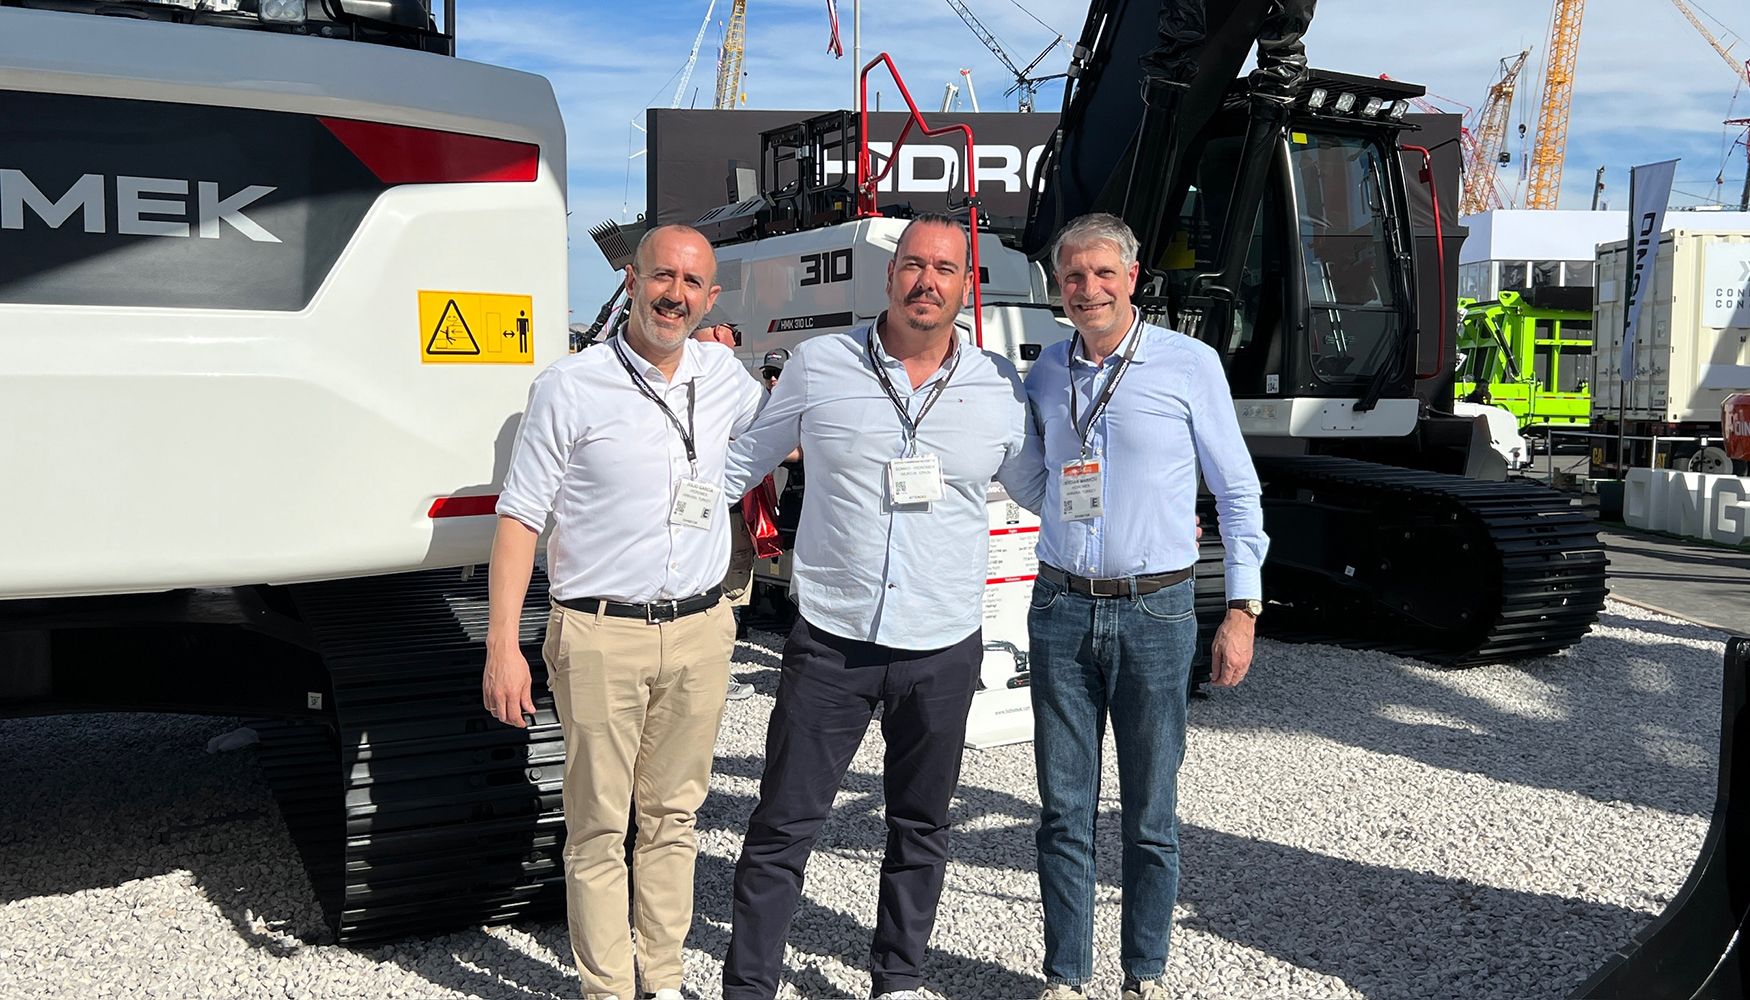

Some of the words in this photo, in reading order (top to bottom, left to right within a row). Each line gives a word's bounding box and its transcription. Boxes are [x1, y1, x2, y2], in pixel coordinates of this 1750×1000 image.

[0, 168, 283, 244] MEK
[800, 247, 853, 287] 310
[1715, 287, 1750, 298] CON
[1714, 299, 1750, 309] CON
[780, 320, 794, 330] HMK
[794, 319, 804, 329] 310
[805, 317, 814, 328] LC
